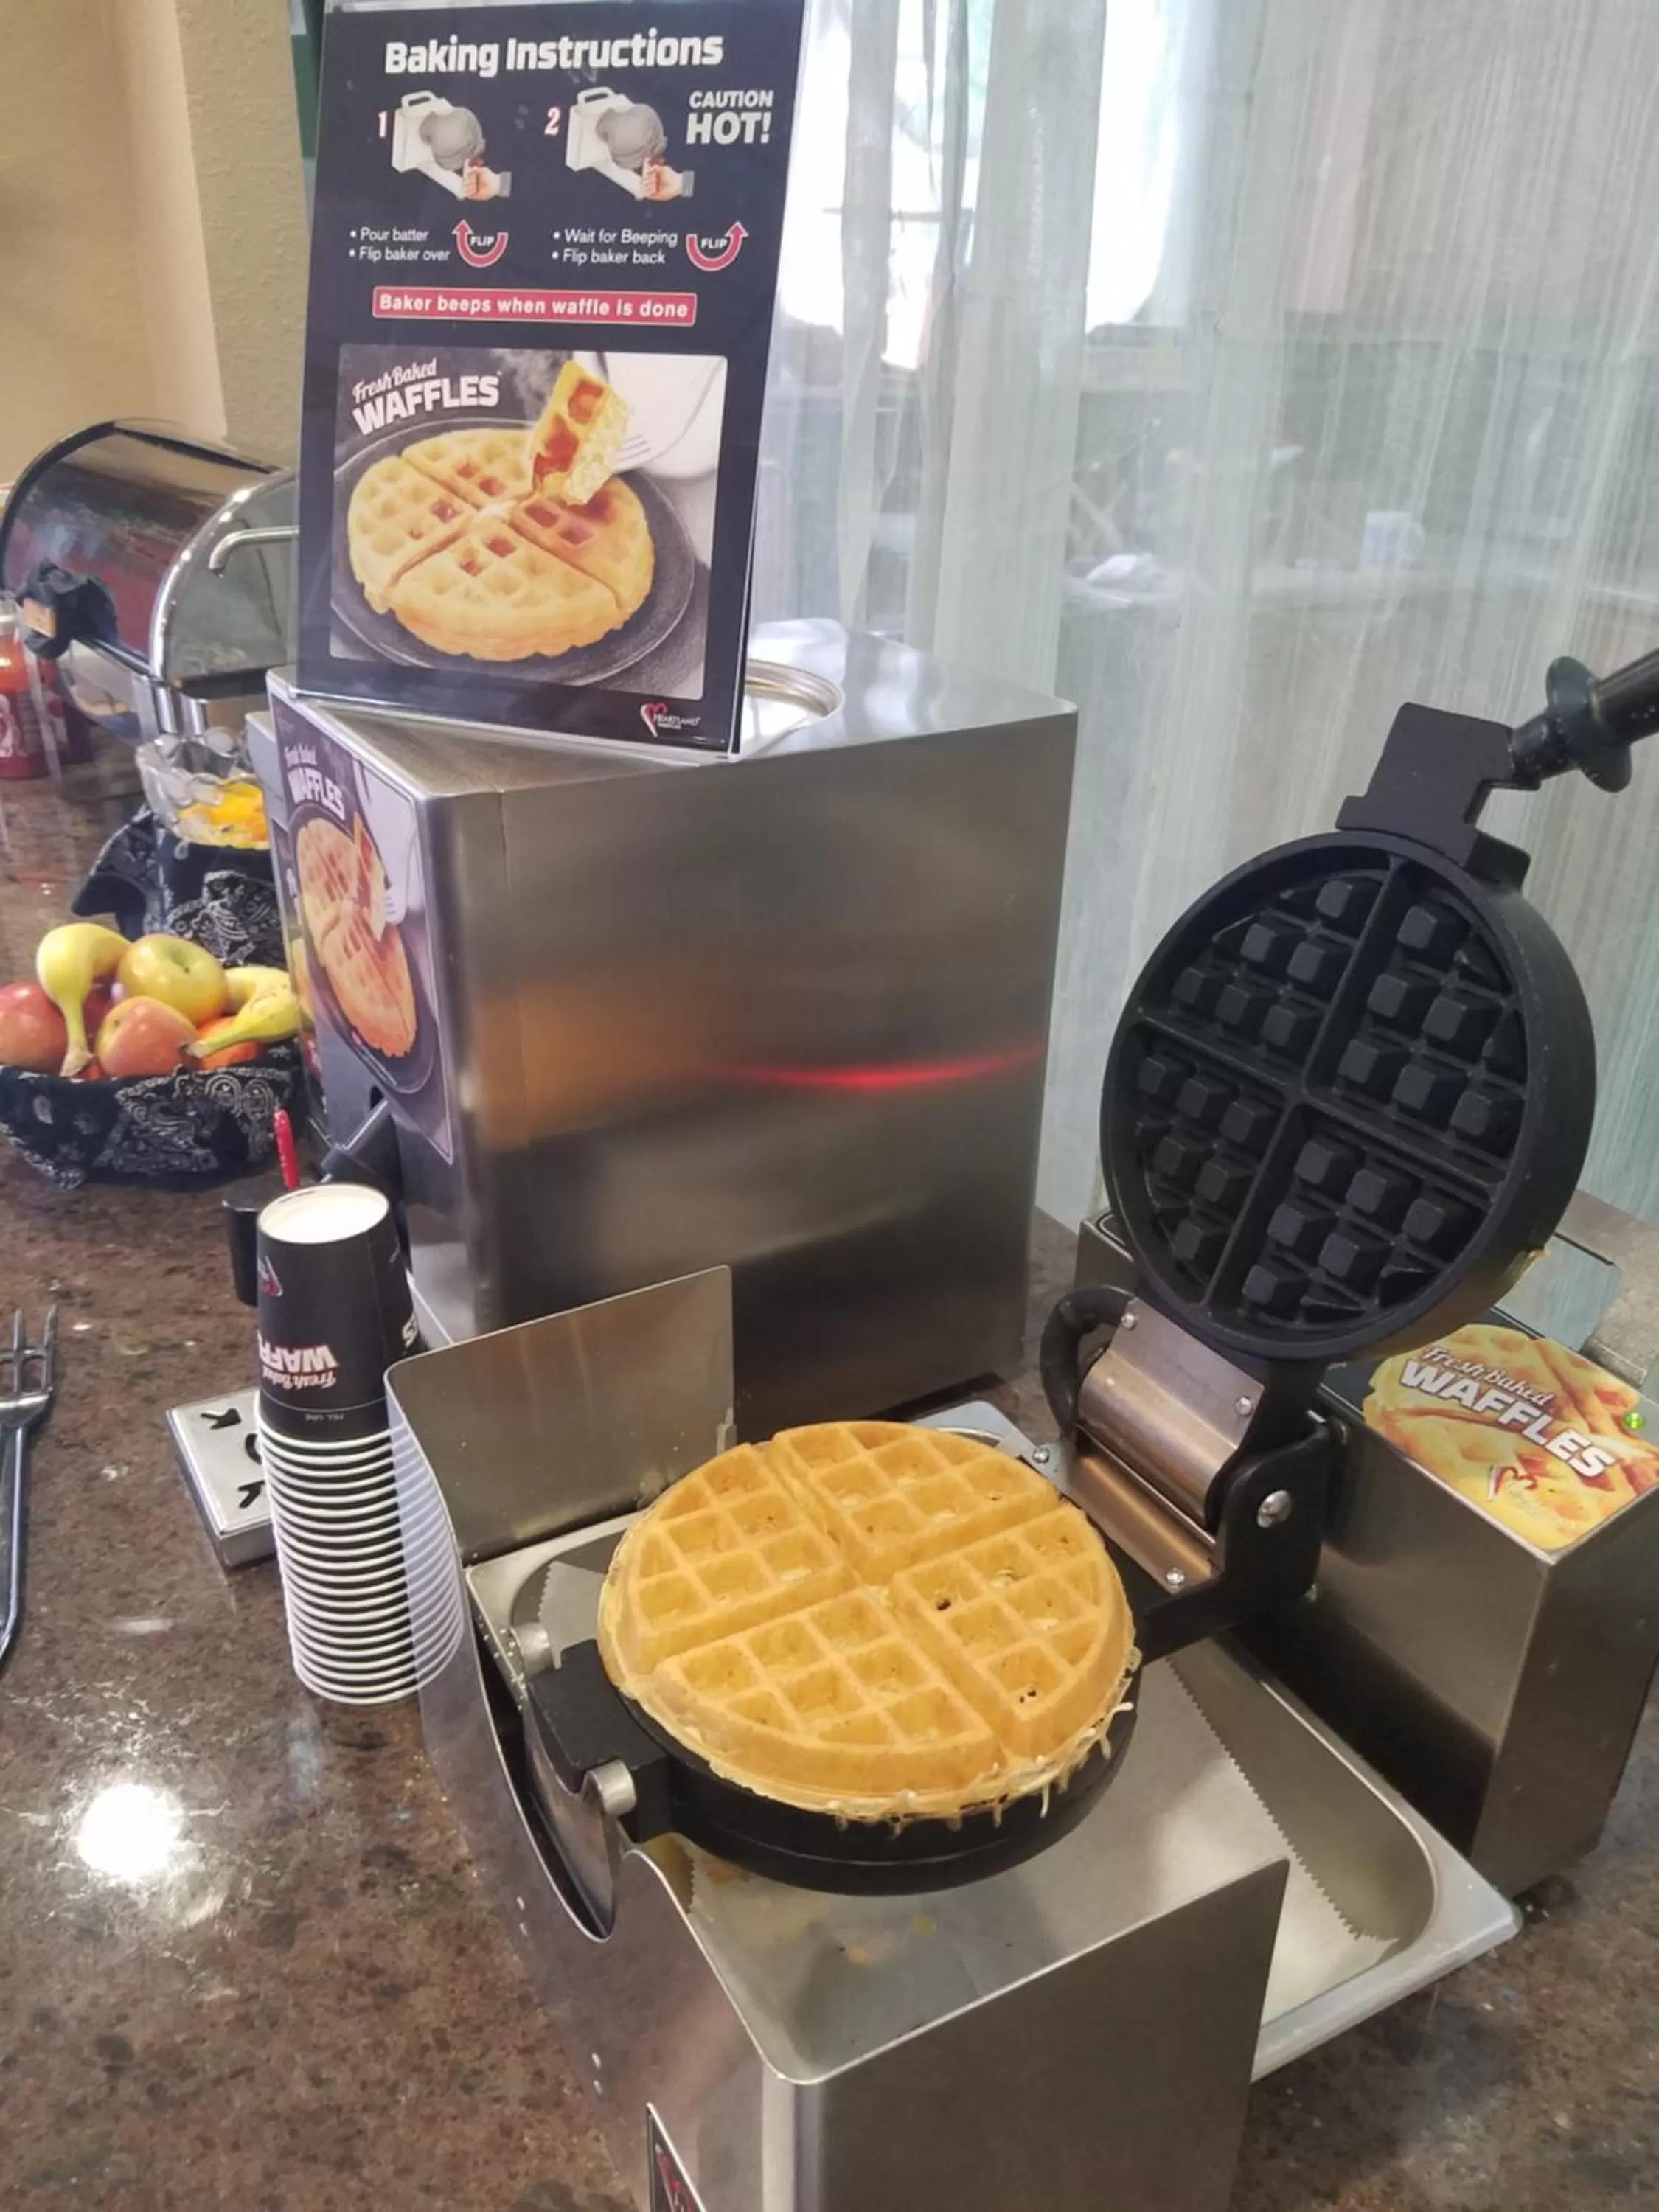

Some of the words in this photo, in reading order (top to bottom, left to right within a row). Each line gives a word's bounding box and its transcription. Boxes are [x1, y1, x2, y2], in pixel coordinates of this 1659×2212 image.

[385, 33, 499, 78] Baking
[506, 27, 724, 70] Instructions
[689, 89, 774, 108] CAUTION
[377, 110, 388, 138] 1
[544, 107, 561, 136] 2
[686, 111, 772, 145] HOT!
[360, 226, 389, 242] Pour
[392, 227, 429, 242] batter
[470, 235, 495, 247] FLIP
[564, 228, 596, 243] Wait
[598, 229, 617, 243] for
[621, 228, 678, 248] Beeping
[700, 237, 728, 250] FLIP
[358, 246, 382, 262] Flip
[384, 247, 420, 261] baker
[422, 250, 451, 262] over
[563, 248, 588, 266] Flip
[590, 249, 629, 264] baker
[632, 249, 666, 265] back
[379, 293, 432, 310] Baker
[437, 295, 492, 315] beeps
[497, 296, 546, 313] when
[551, 298, 610, 316] waffle
[616, 299, 633, 316] is
[639, 299, 688, 318] done
[352, 371, 392, 404] Fresh
[391, 357, 437, 386] Baked
[351, 375, 500, 436] WAFFLES
[287, 766, 345, 821] WAFFLES
[1422, 1346, 1486, 1378] Fresh
[1484, 1368, 1556, 1406] Baked
[1399, 1360, 1616, 1478] WAFFLES
